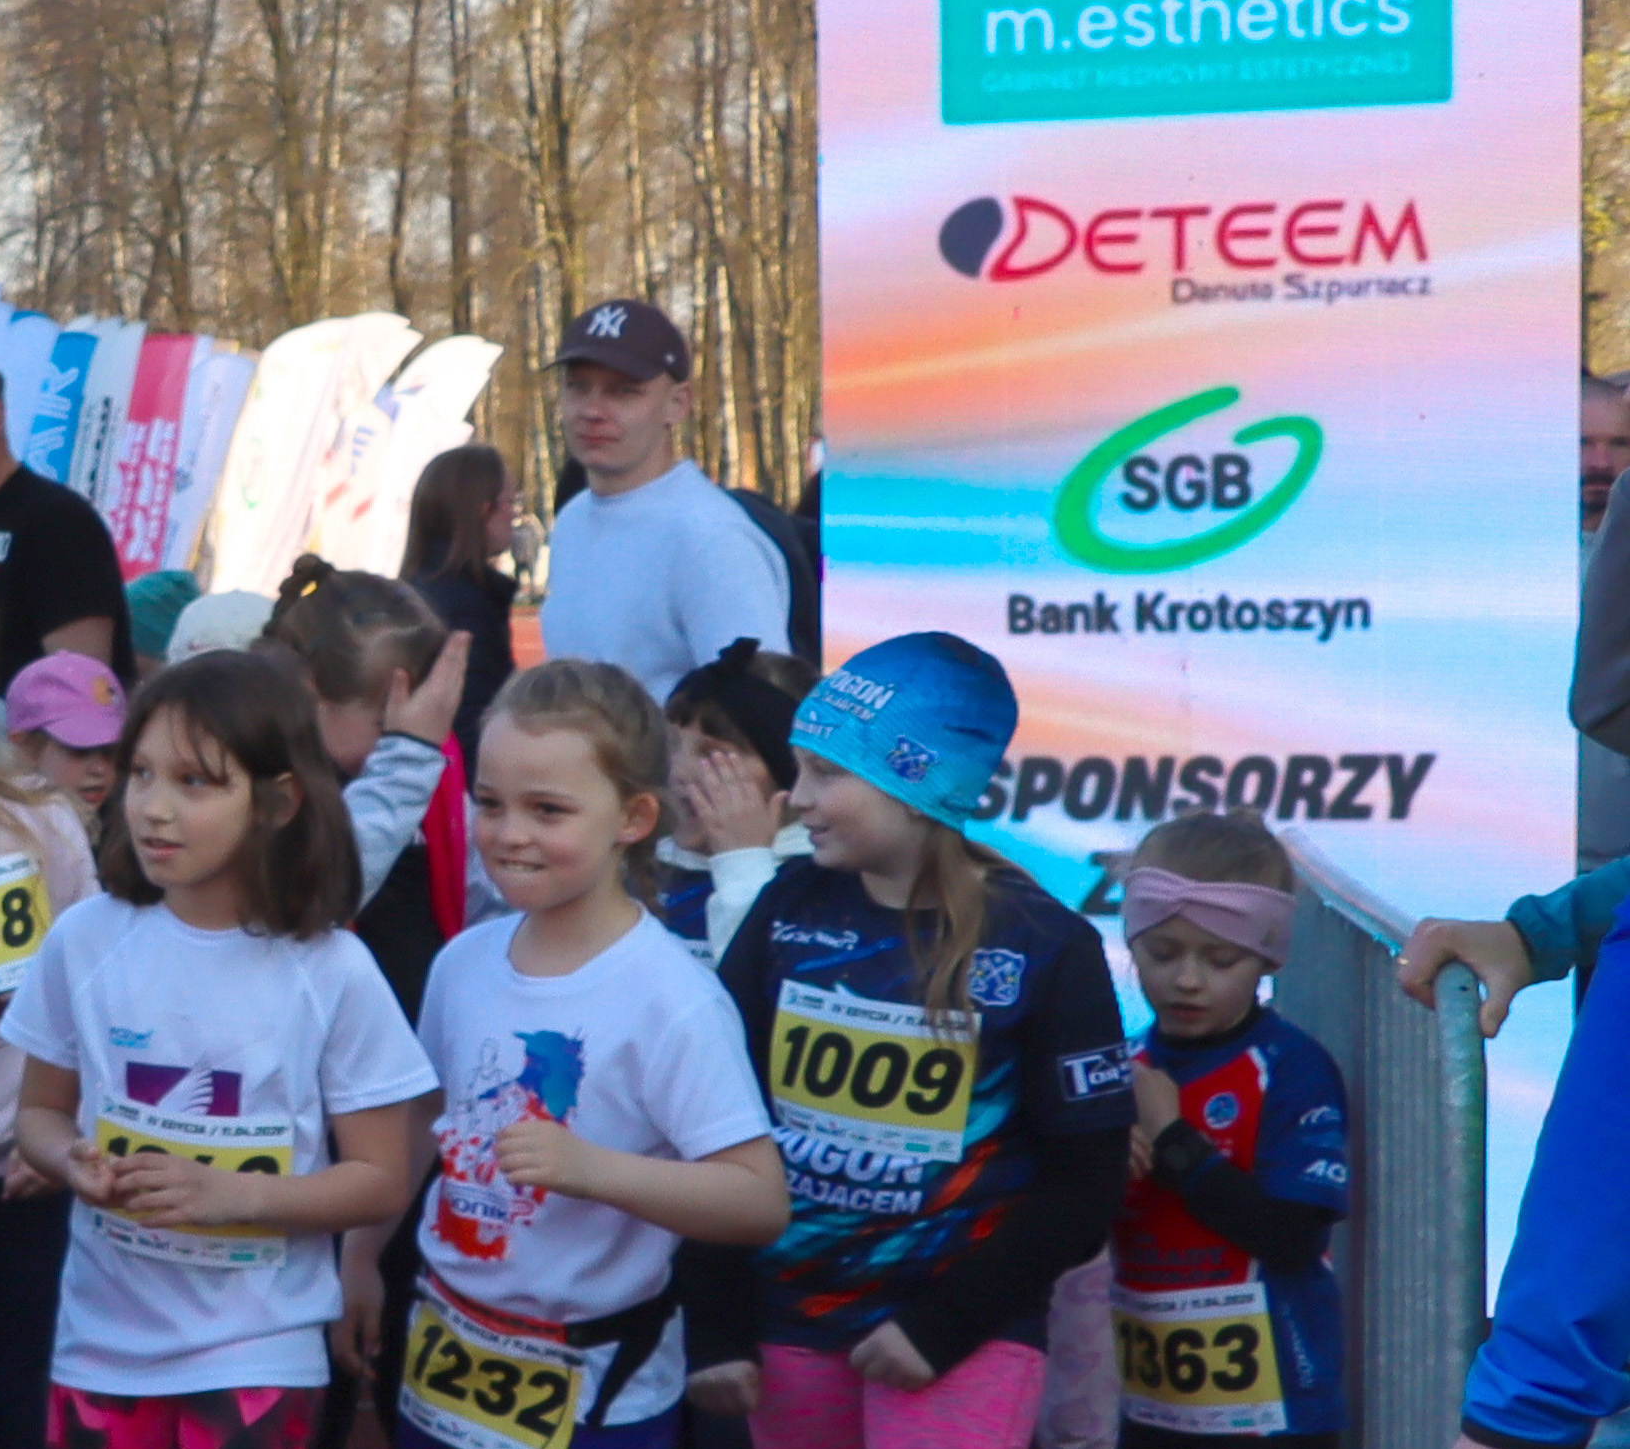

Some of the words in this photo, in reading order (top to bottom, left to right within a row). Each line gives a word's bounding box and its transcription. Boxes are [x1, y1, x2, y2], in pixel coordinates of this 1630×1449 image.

[989, 195, 1431, 283] DETEEM
[1121, 453, 1254, 511] SGB
[1008, 593, 1120, 635] Bank
[1136, 592, 1371, 643] Krotoszyn
[971, 752, 1437, 823] SPONSORZY
[781, 1025, 964, 1116] 1009
[414, 1325, 570, 1439] 1232
[1119, 1321, 1260, 1394] 1363
